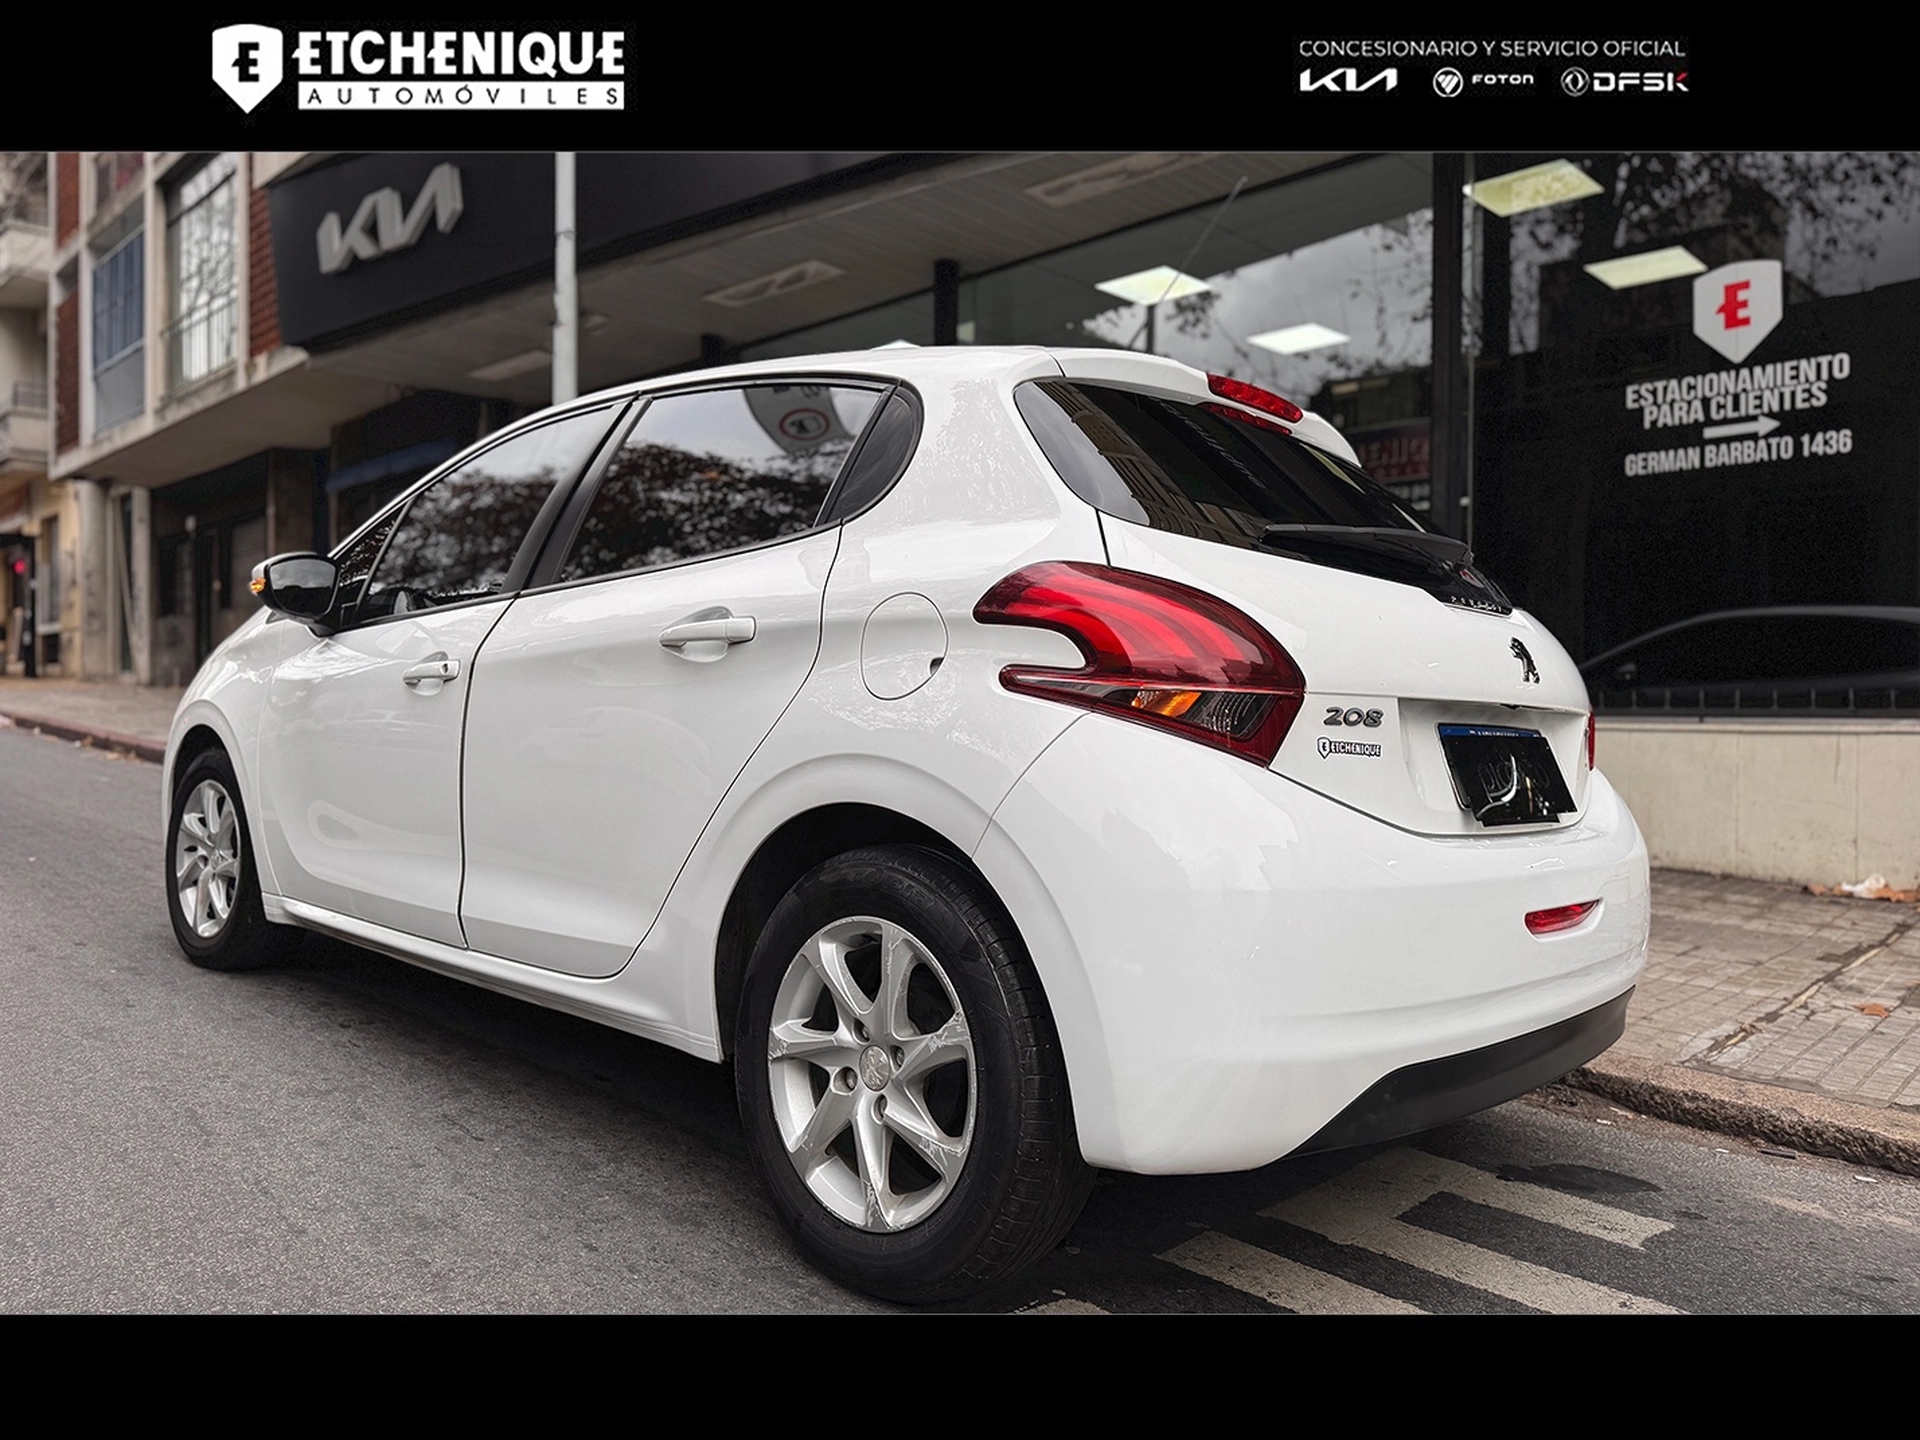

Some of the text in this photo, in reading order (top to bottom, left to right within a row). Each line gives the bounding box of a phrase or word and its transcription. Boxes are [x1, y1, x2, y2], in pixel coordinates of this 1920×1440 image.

[316, 162, 464, 275] KIA
[1625, 352, 1851, 410] ESTACIONAMIENTO
[1643, 381, 1828, 430] PARA CLIENTES
[1624, 429, 1853, 477] GERMAN BARBATO 1436
[1323, 706, 1384, 728] 208
[1331, 741, 1381, 756] ETCHENIQUE
